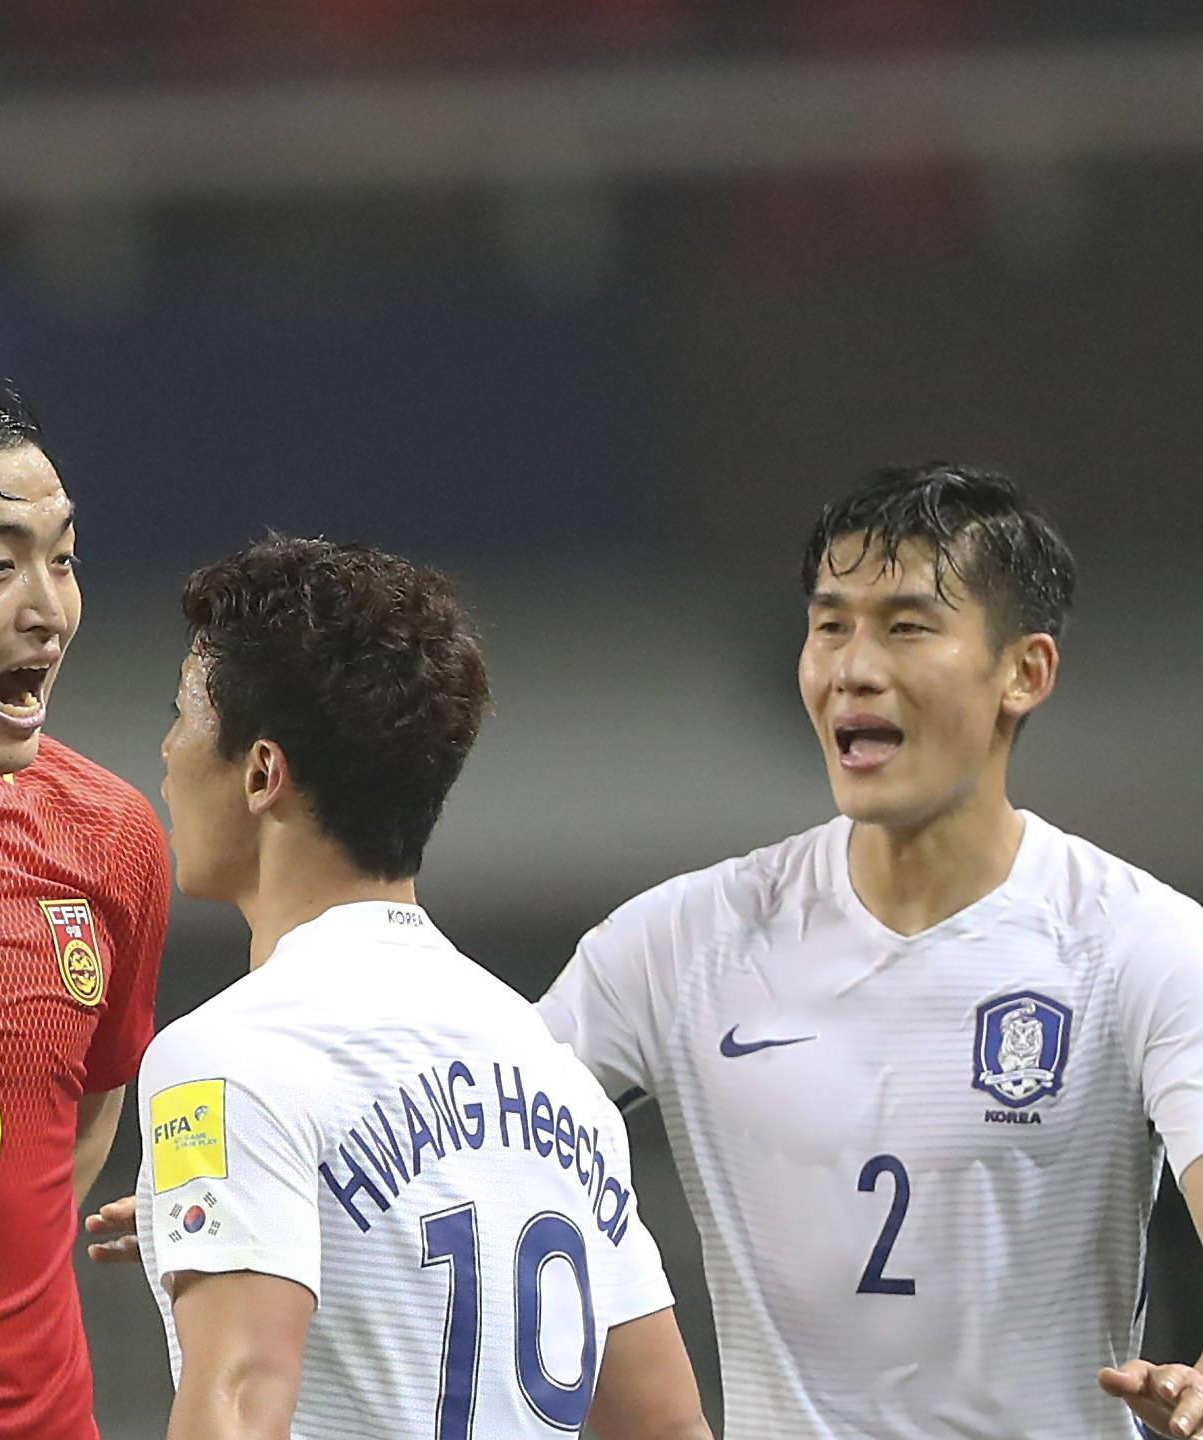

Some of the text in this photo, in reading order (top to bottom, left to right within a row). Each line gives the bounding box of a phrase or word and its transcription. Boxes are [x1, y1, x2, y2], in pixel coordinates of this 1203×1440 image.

[47, 905, 89, 925] CFA
[387, 908, 424, 927] KOREA
[984, 1109, 1041, 1124] KOREA
[154, 1116, 191, 1144] FIFA
[318, 1061, 485, 1233] HWANG
[856, 1154, 916, 1295] 2
